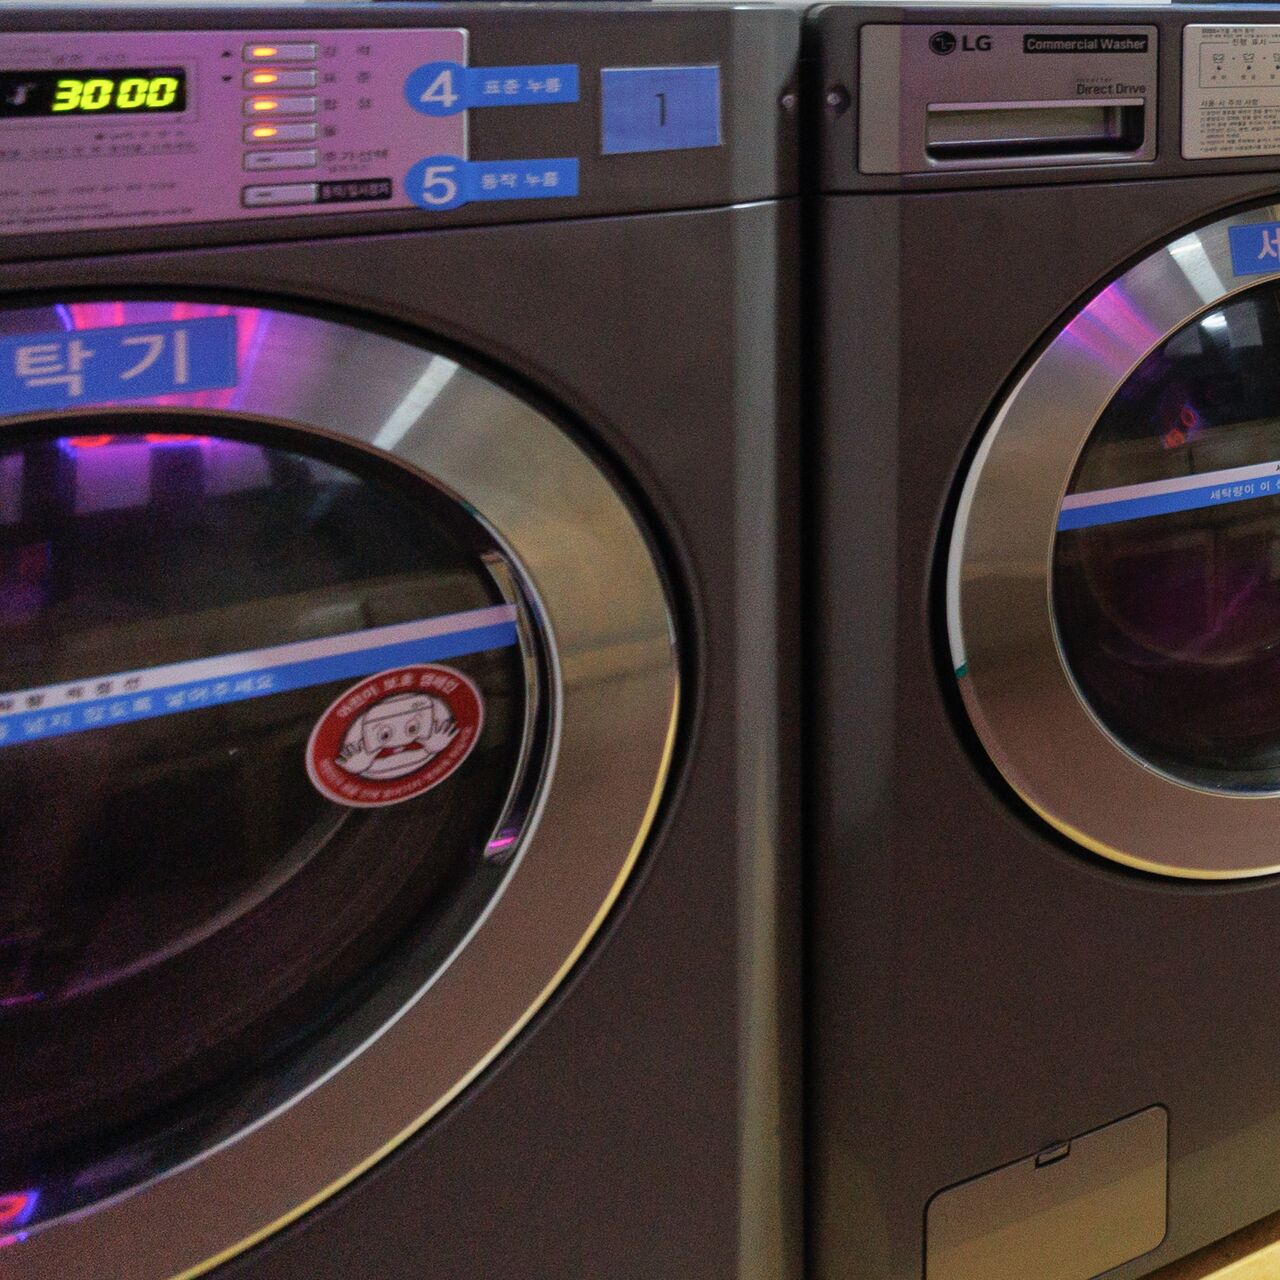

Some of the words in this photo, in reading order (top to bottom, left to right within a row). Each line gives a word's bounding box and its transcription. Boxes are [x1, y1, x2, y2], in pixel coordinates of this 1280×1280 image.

[962, 35, 992, 52] LG
[1026, 38, 1098, 51] Commercial
[1101, 36, 1147, 51] Washer
[420, 70, 458, 108] 4
[1077, 83, 1113, 96] Direct
[1115, 82, 1147, 95] Drive
[654, 92, 666, 127] 1
[422, 165, 457, 206] 5
